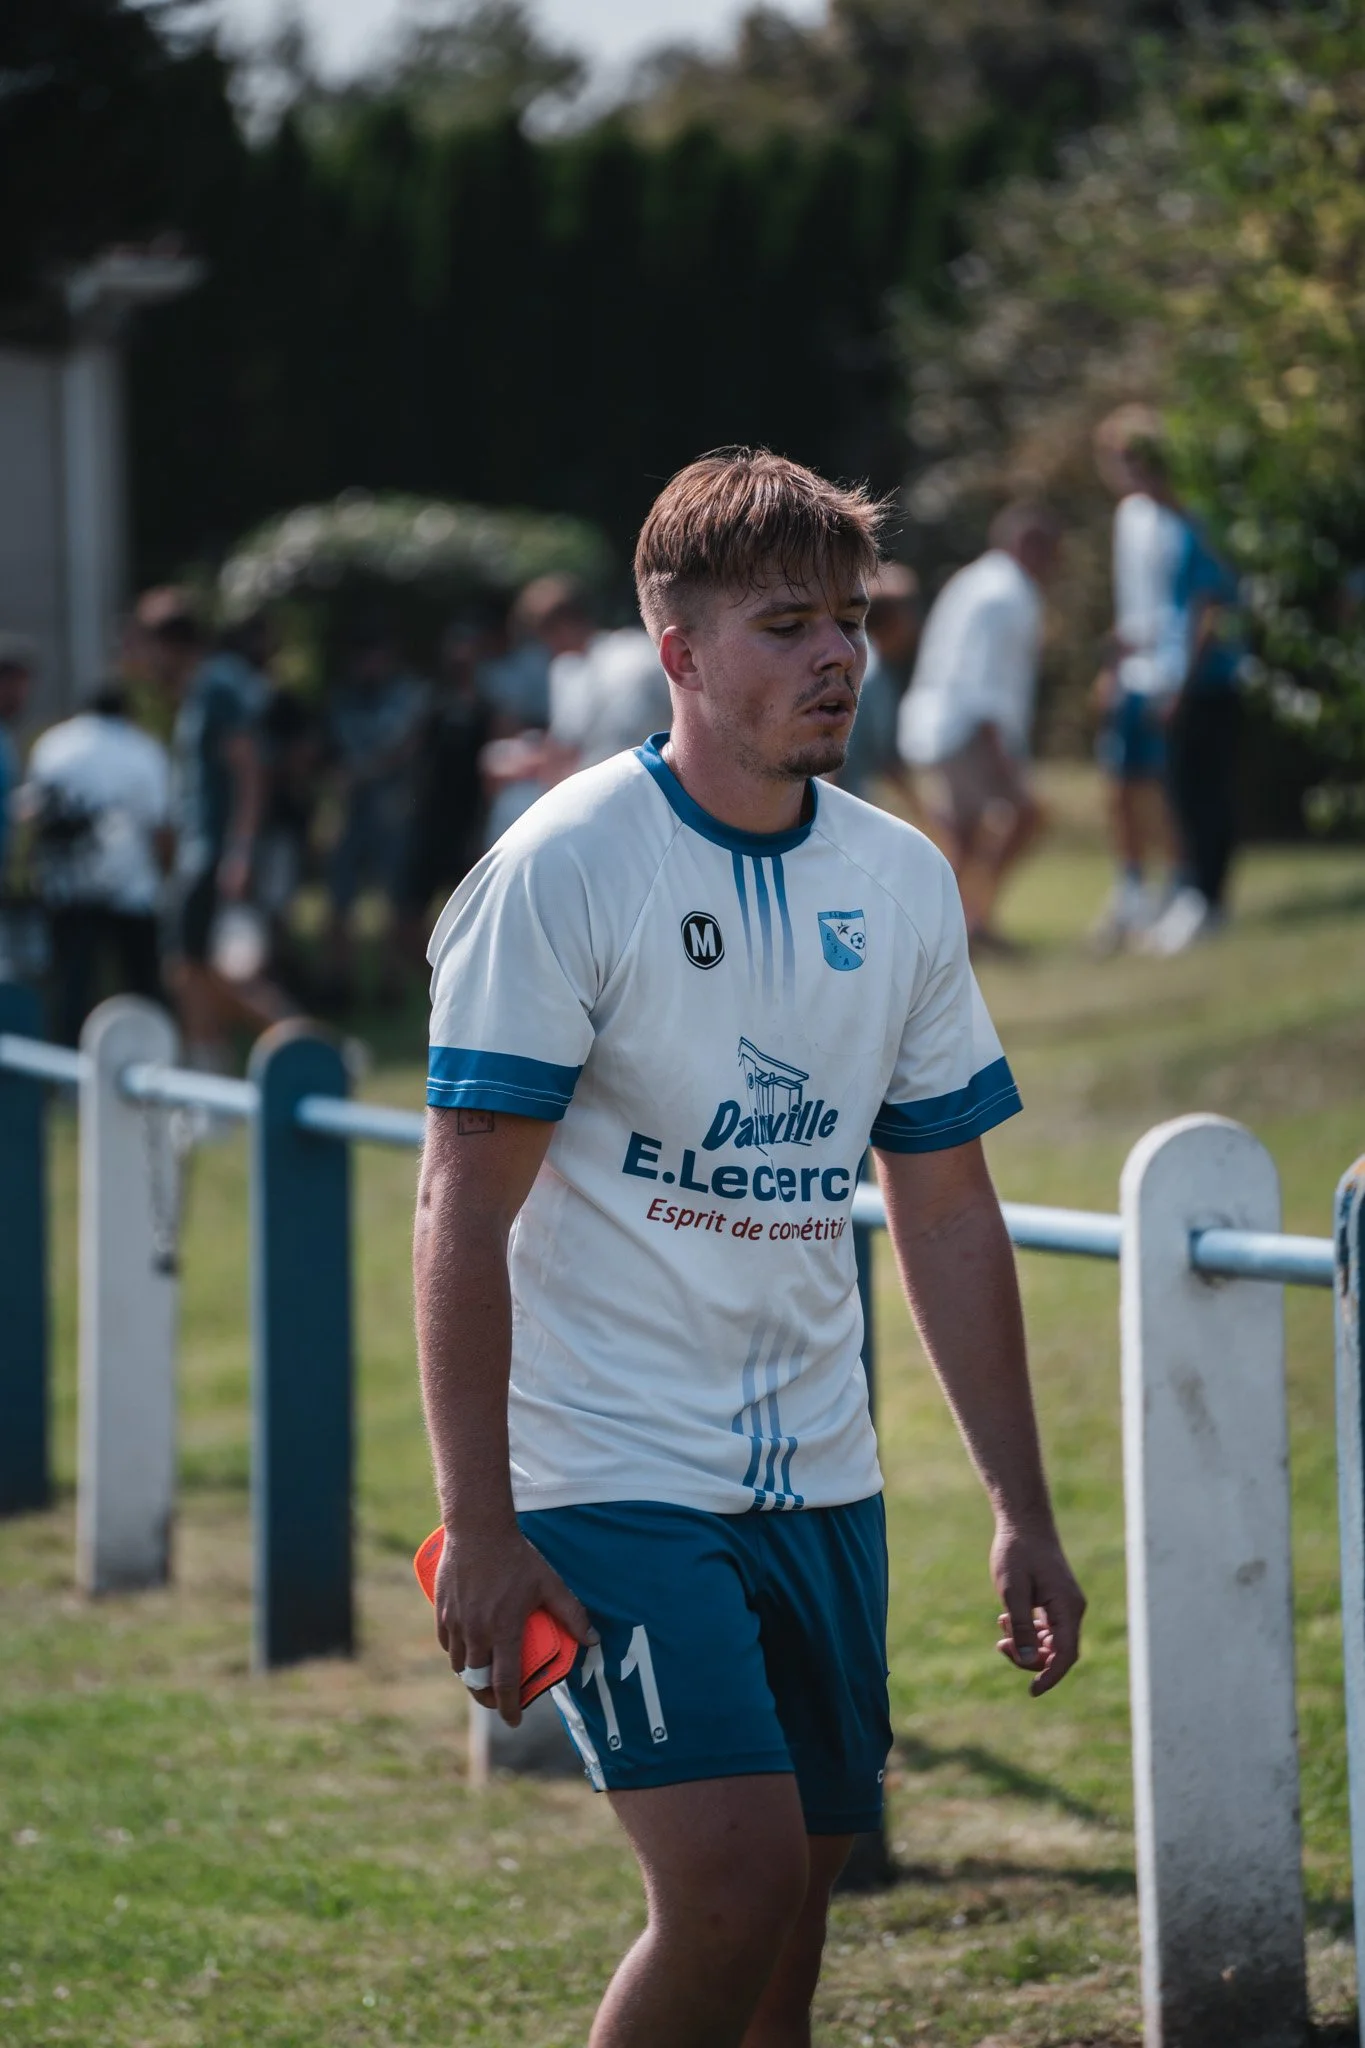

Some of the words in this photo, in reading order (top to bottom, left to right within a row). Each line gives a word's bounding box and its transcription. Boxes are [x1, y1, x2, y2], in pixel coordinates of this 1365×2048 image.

[688, 922, 717, 957] M
[646, 1198, 727, 1233] Esprit
[731, 1216, 764, 1241] de
[581, 1624, 668, 1751] 11
